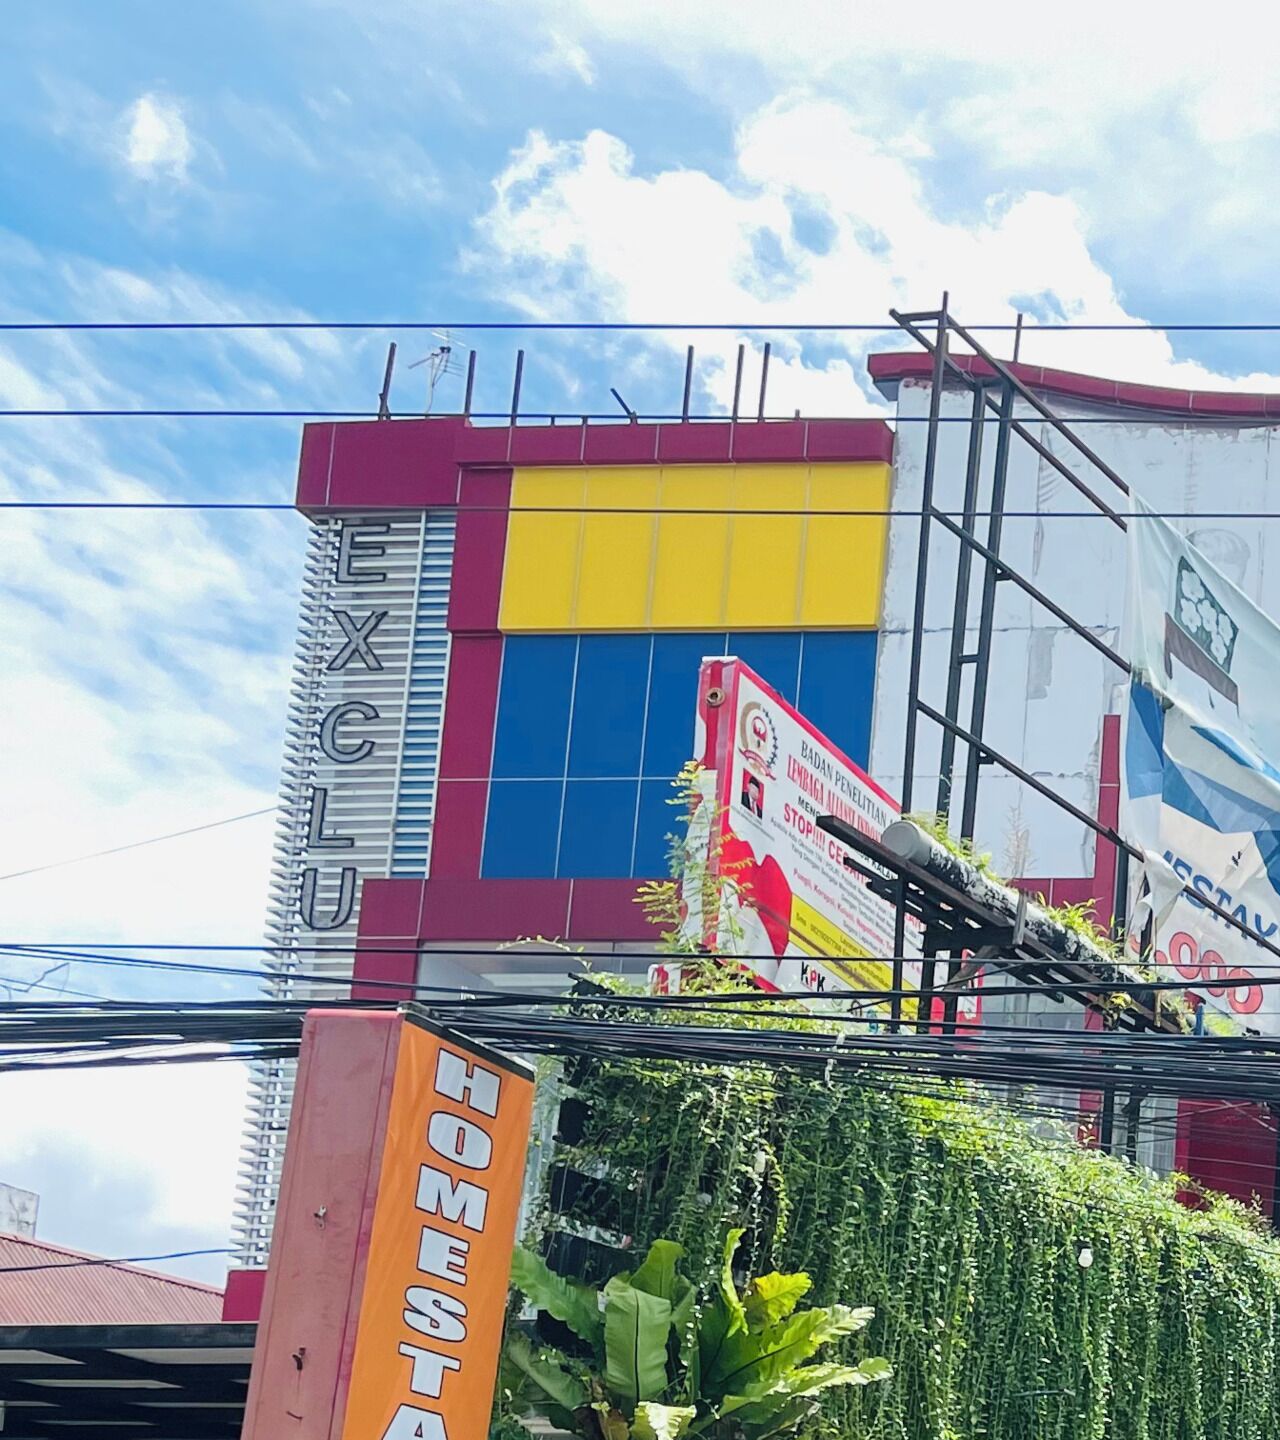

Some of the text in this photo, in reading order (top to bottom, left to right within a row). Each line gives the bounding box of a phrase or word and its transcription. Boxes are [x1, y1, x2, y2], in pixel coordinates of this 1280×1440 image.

[787, 754, 824, 807] LEMBAGA
[801, 739, 834, 781] BADAN
[835, 768, 887, 828] PENELITIAN
[801, 961, 825, 992] KPK
